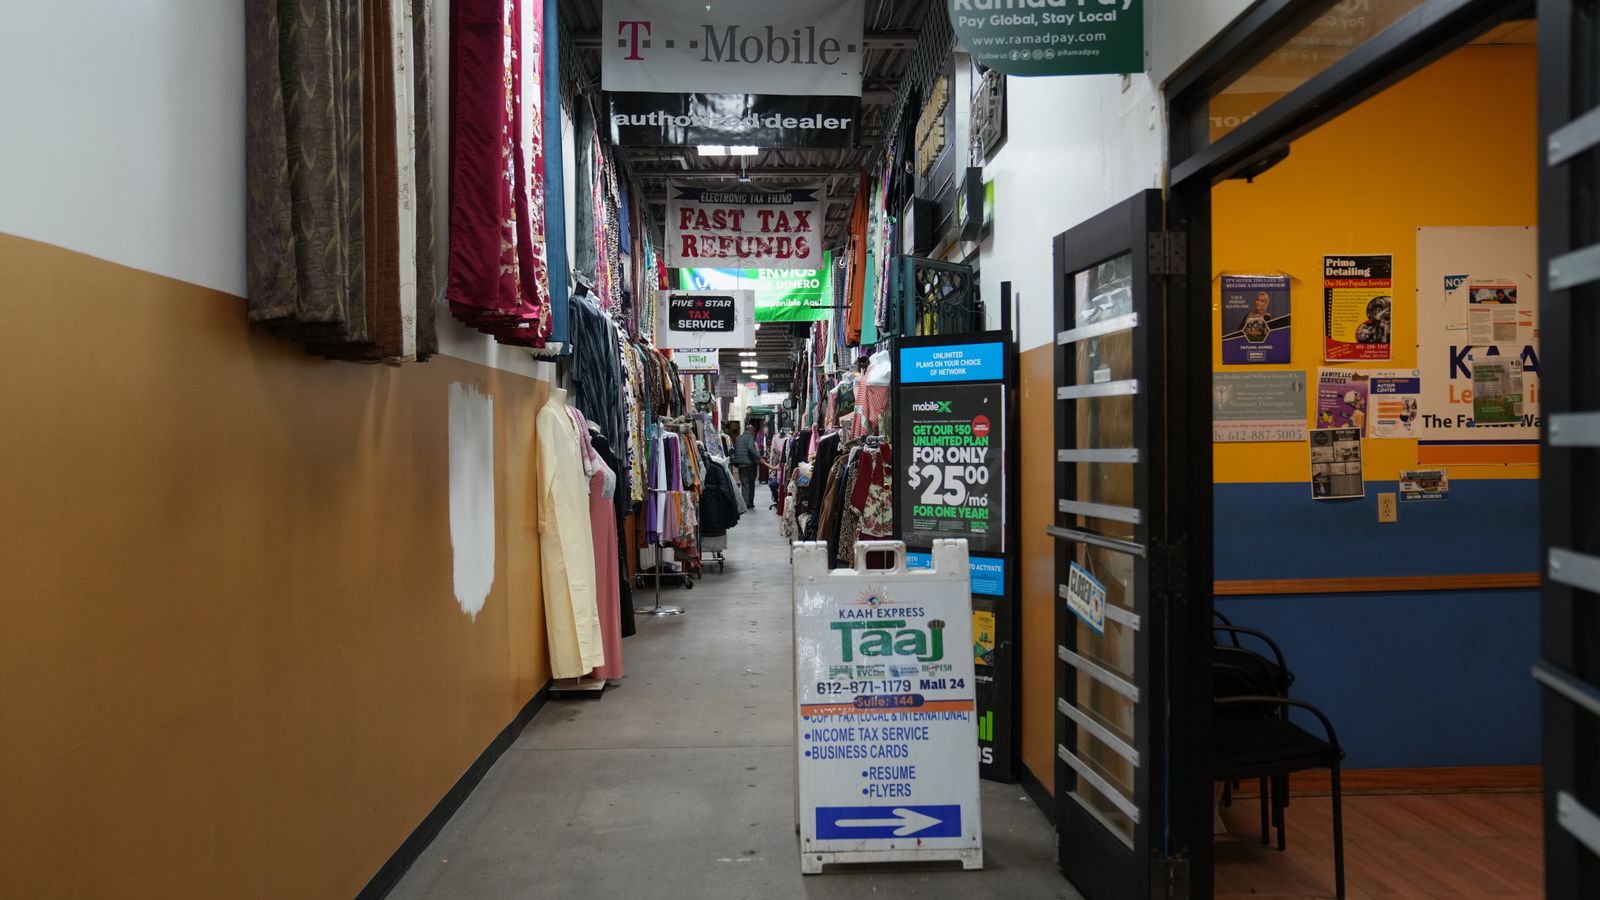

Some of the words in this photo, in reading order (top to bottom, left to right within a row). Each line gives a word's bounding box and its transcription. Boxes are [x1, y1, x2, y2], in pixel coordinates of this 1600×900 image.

[959, 16, 985, 29] Pay
[990, 13, 1038, 26] Global,
[1042, 12, 1074, 25] Stay
[1079, 10, 1117, 23] Local
[701, 24, 841, 65] Mobile
[972, 32, 1106, 46] www.ramadpay.com
[765, 114, 852, 129] dealer
[701, 192, 747, 203] ELECTRONIC
[750, 193, 763, 204] TAX
[767, 193, 792, 204] FILING
[679, 207, 745, 232] FAST
[757, 209, 812, 232] TAX
[681, 234, 810, 259] REFUNDS
[1326, 258, 1356, 267] Primo
[759, 269, 817, 279] ENVIOS
[1326, 267, 1371, 277] Detailing
[775, 279, 820, 290] DINERO
[688, 310, 710, 319] TAX
[678, 320, 724, 329] SERVICE
[913, 401, 952, 413] mobileX
[1422, 414, 1452, 428] The
[913, 425, 931, 435] GET
[933, 425, 953, 435] OUR
[955, 424, 971, 435] $50
[1228, 430, 1302, 441] 612-887-5005
[913, 436, 963, 446] UNLIMITED
[964, 436, 989, 446] PLAN
[913, 447, 944, 463] FOR
[946, 447, 988, 463] ONLY
[913, 506, 934, 517] FOR
[935, 506, 957, 517] ONE
[958, 507, 989, 519] YEAR!
[976, 564, 1002, 572] ACTIVATE
[839, 608, 873, 619] KAAH
[877, 607, 925, 618] EXPRESS
[817, 680, 912, 694] 612-871-1179
[919, 678, 946, 691] Mall
[949, 678, 965, 690] 24
[856, 696, 889, 708] Suite:
[894, 695, 914, 706] 144
[838, 714, 854, 723] FAX
[892, 712, 897, 721] &
[811, 728, 855, 742] INCOME
[858, 727, 879, 741] TAX
[882, 727, 929, 741] SERVICE
[812, 745, 867, 759] BUSINESS
[870, 745, 909, 758] CARDS
[869, 766, 916, 780] RESUME
[869, 783, 912, 797] FLYERS
